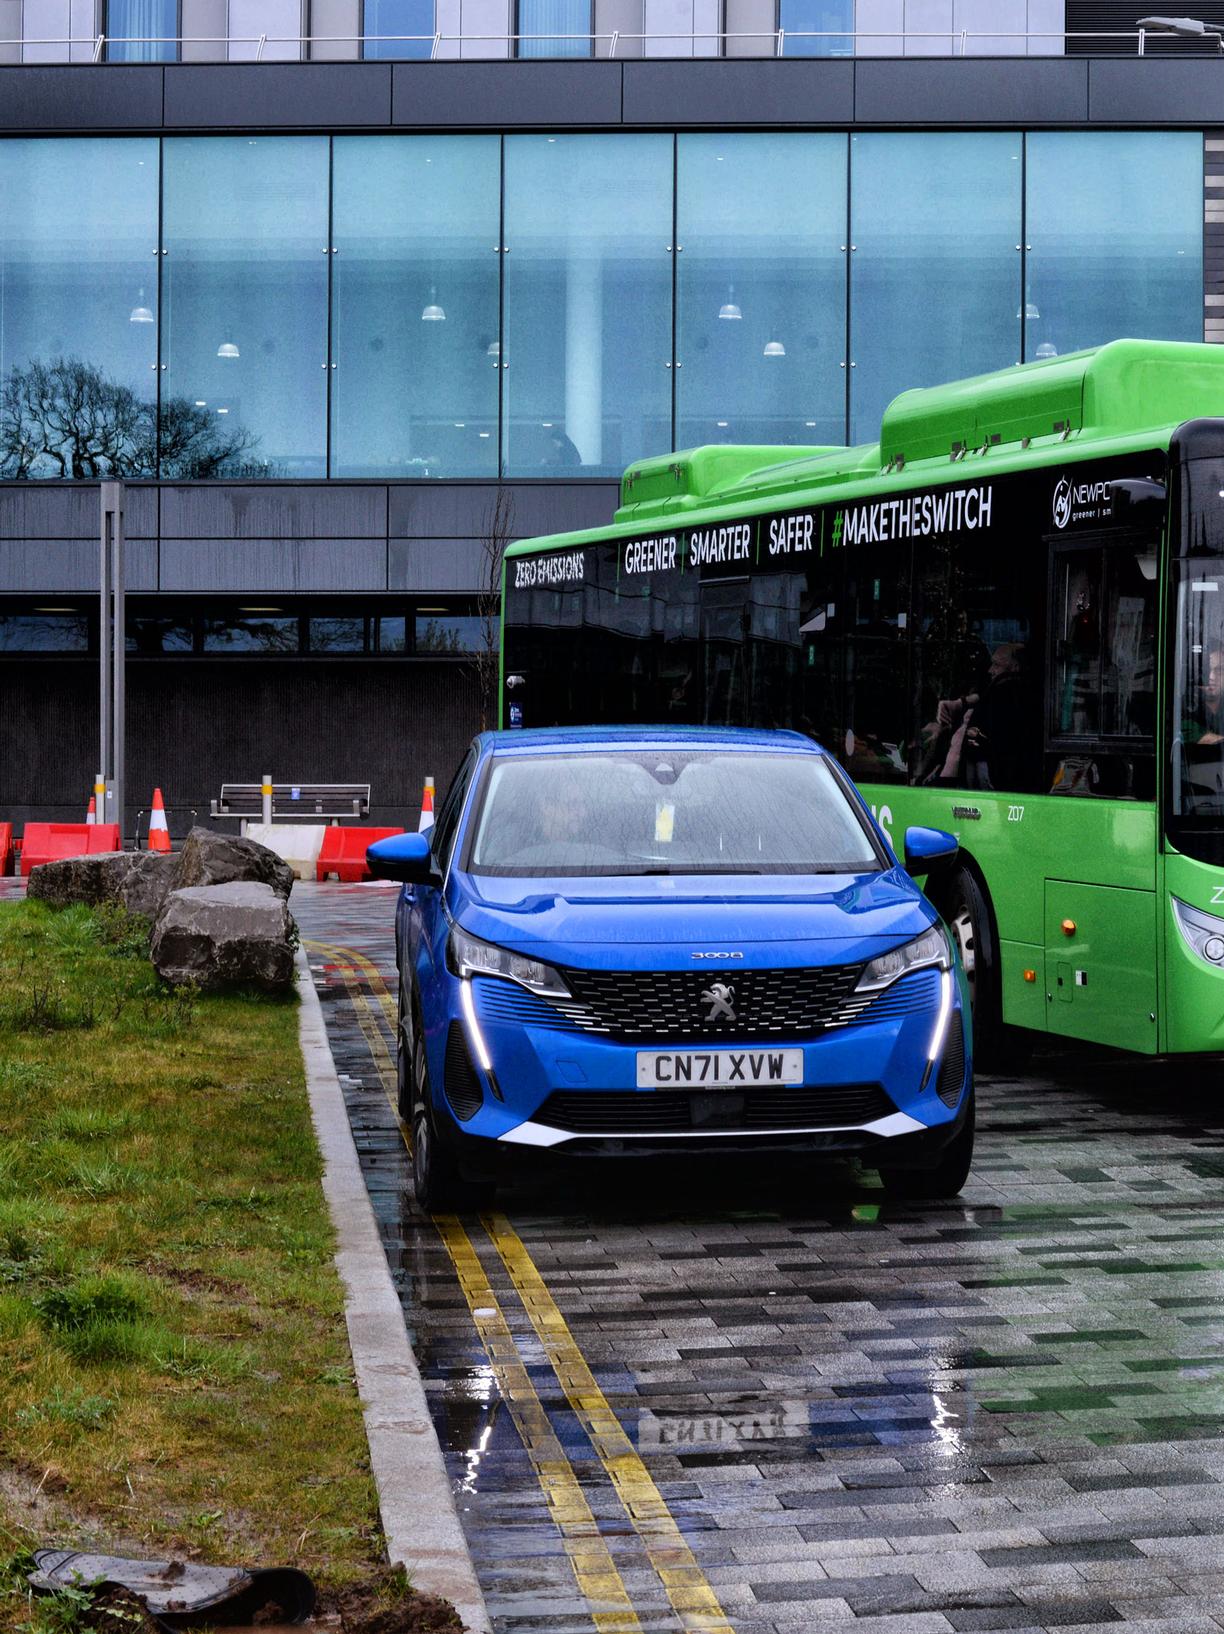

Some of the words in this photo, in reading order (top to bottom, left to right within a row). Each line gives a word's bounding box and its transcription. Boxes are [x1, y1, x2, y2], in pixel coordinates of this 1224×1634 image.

[624, 536, 677, 575] GREENER
[689, 523, 751, 567] SMARTER
[768, 513, 814, 555] SAFER
[831, 485, 993, 548] #MAKETHESWITCH
[514, 561, 537, 588] ZERO
[537, 552, 585, 584] EMISSIONS
[655, 1054, 720, 1082] CN71
[728, 1053, 784, 1080] XVW
